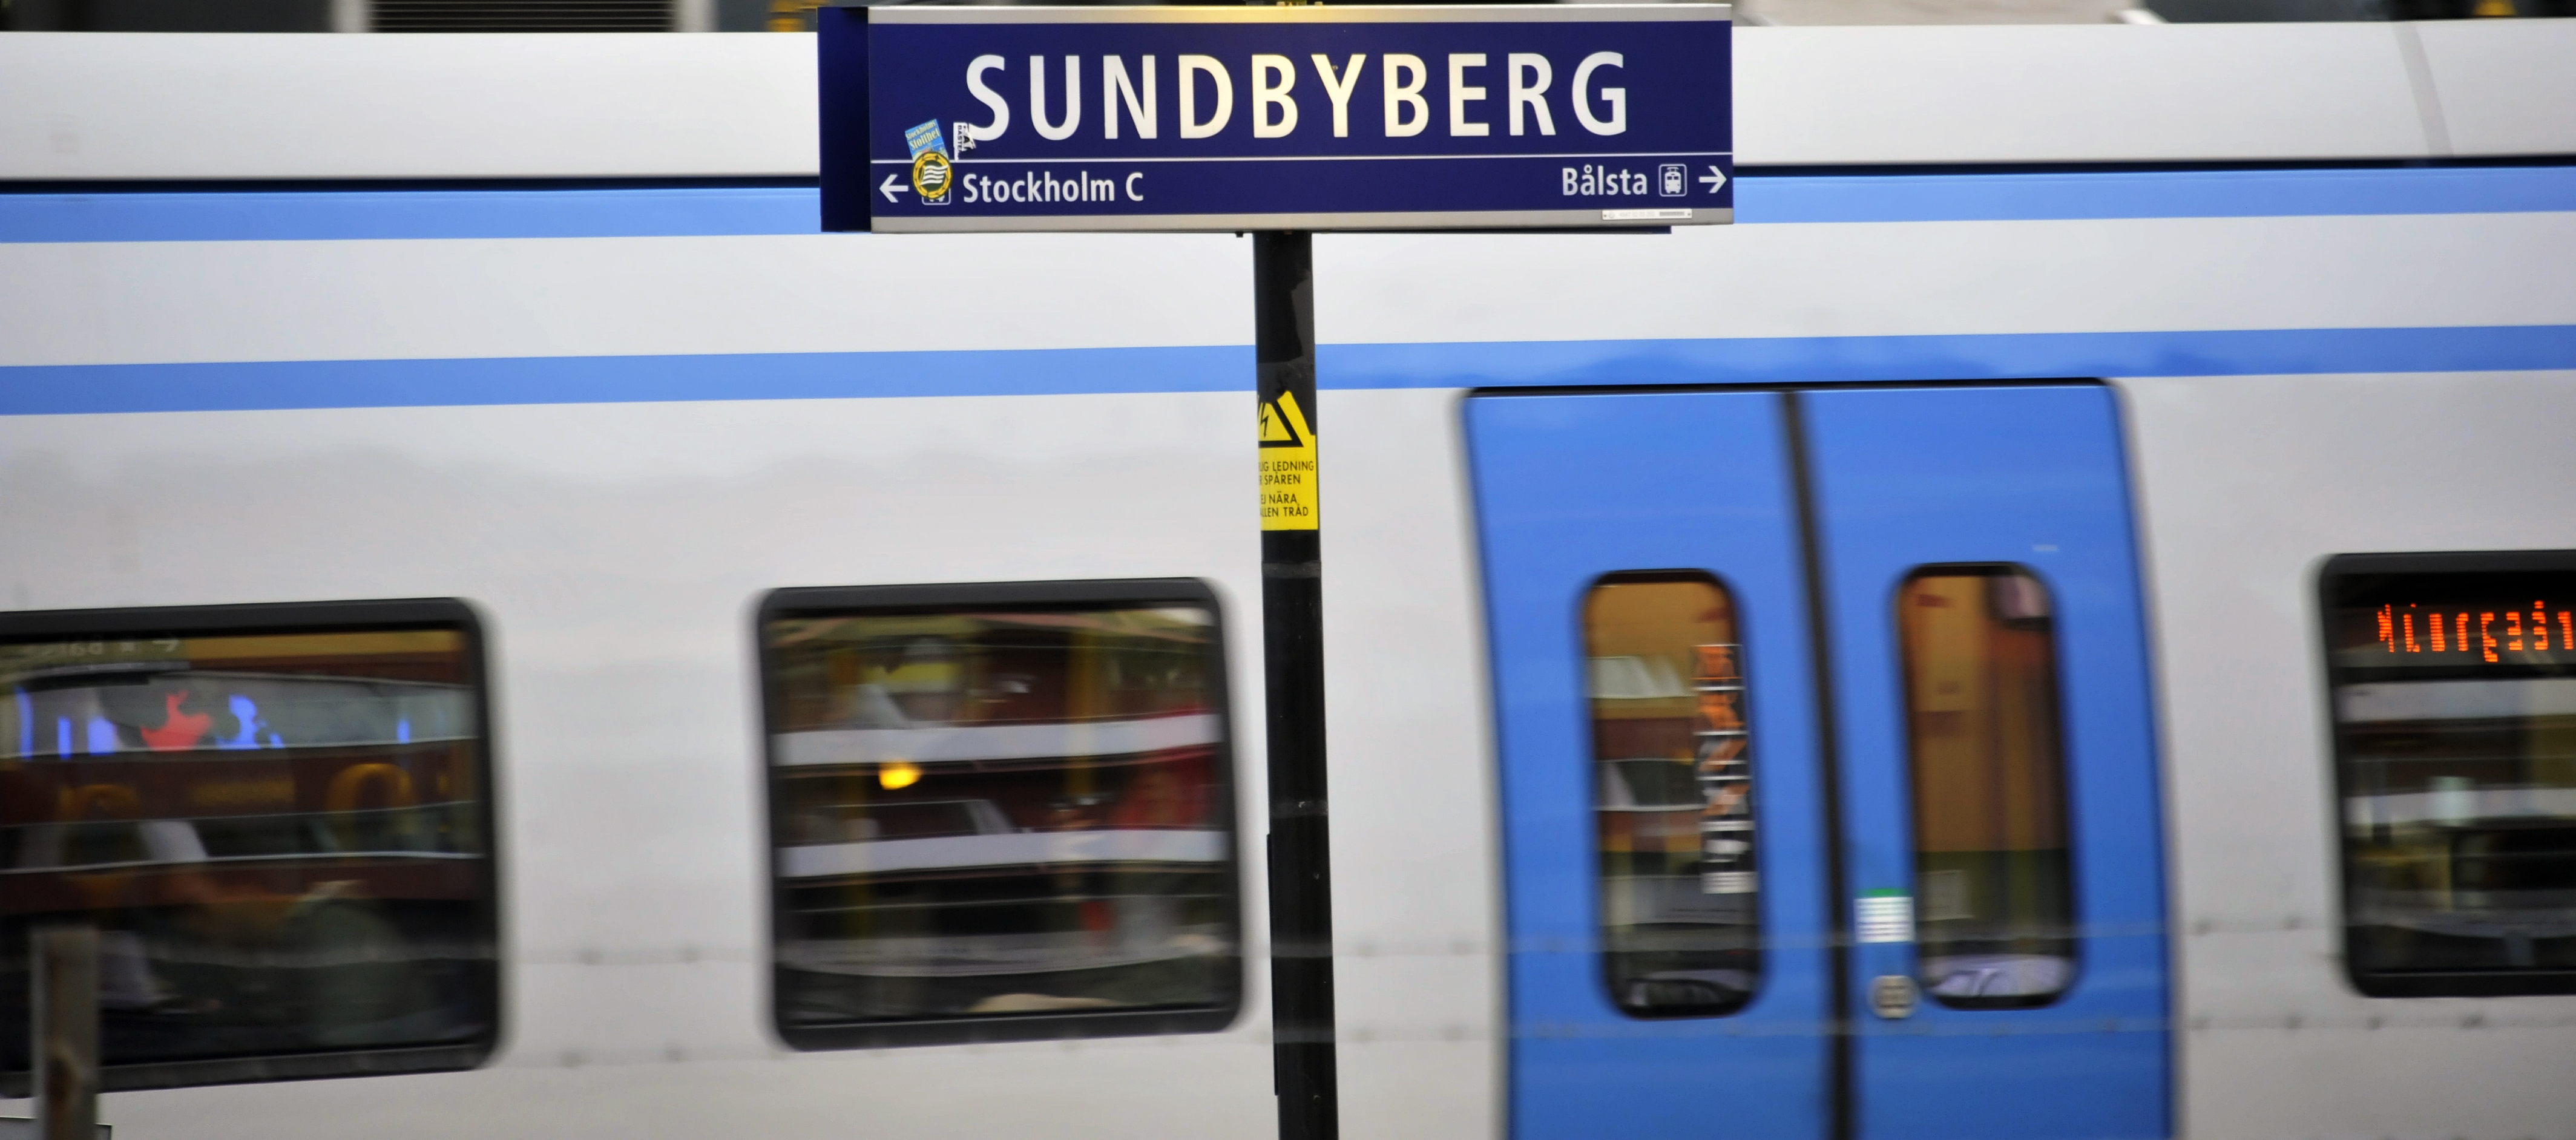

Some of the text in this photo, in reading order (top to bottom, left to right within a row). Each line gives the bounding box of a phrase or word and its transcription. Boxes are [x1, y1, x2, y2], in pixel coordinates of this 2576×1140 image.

[966, 51, 1627, 141] SUNDBYBERG
[905, 120, 936, 139] Stockholms
[909, 128, 941, 150] Stolthet
[963, 171, 1144, 203] Stockholm C
[1562, 165, 1648, 195] Bålsta
[1272, 461, 1314, 472] LEDNING
[1264, 472, 1301, 485] SPÅREN
[1269, 491, 1297, 504] NÄRA
[1283, 503, 1309, 517] TRÅD
